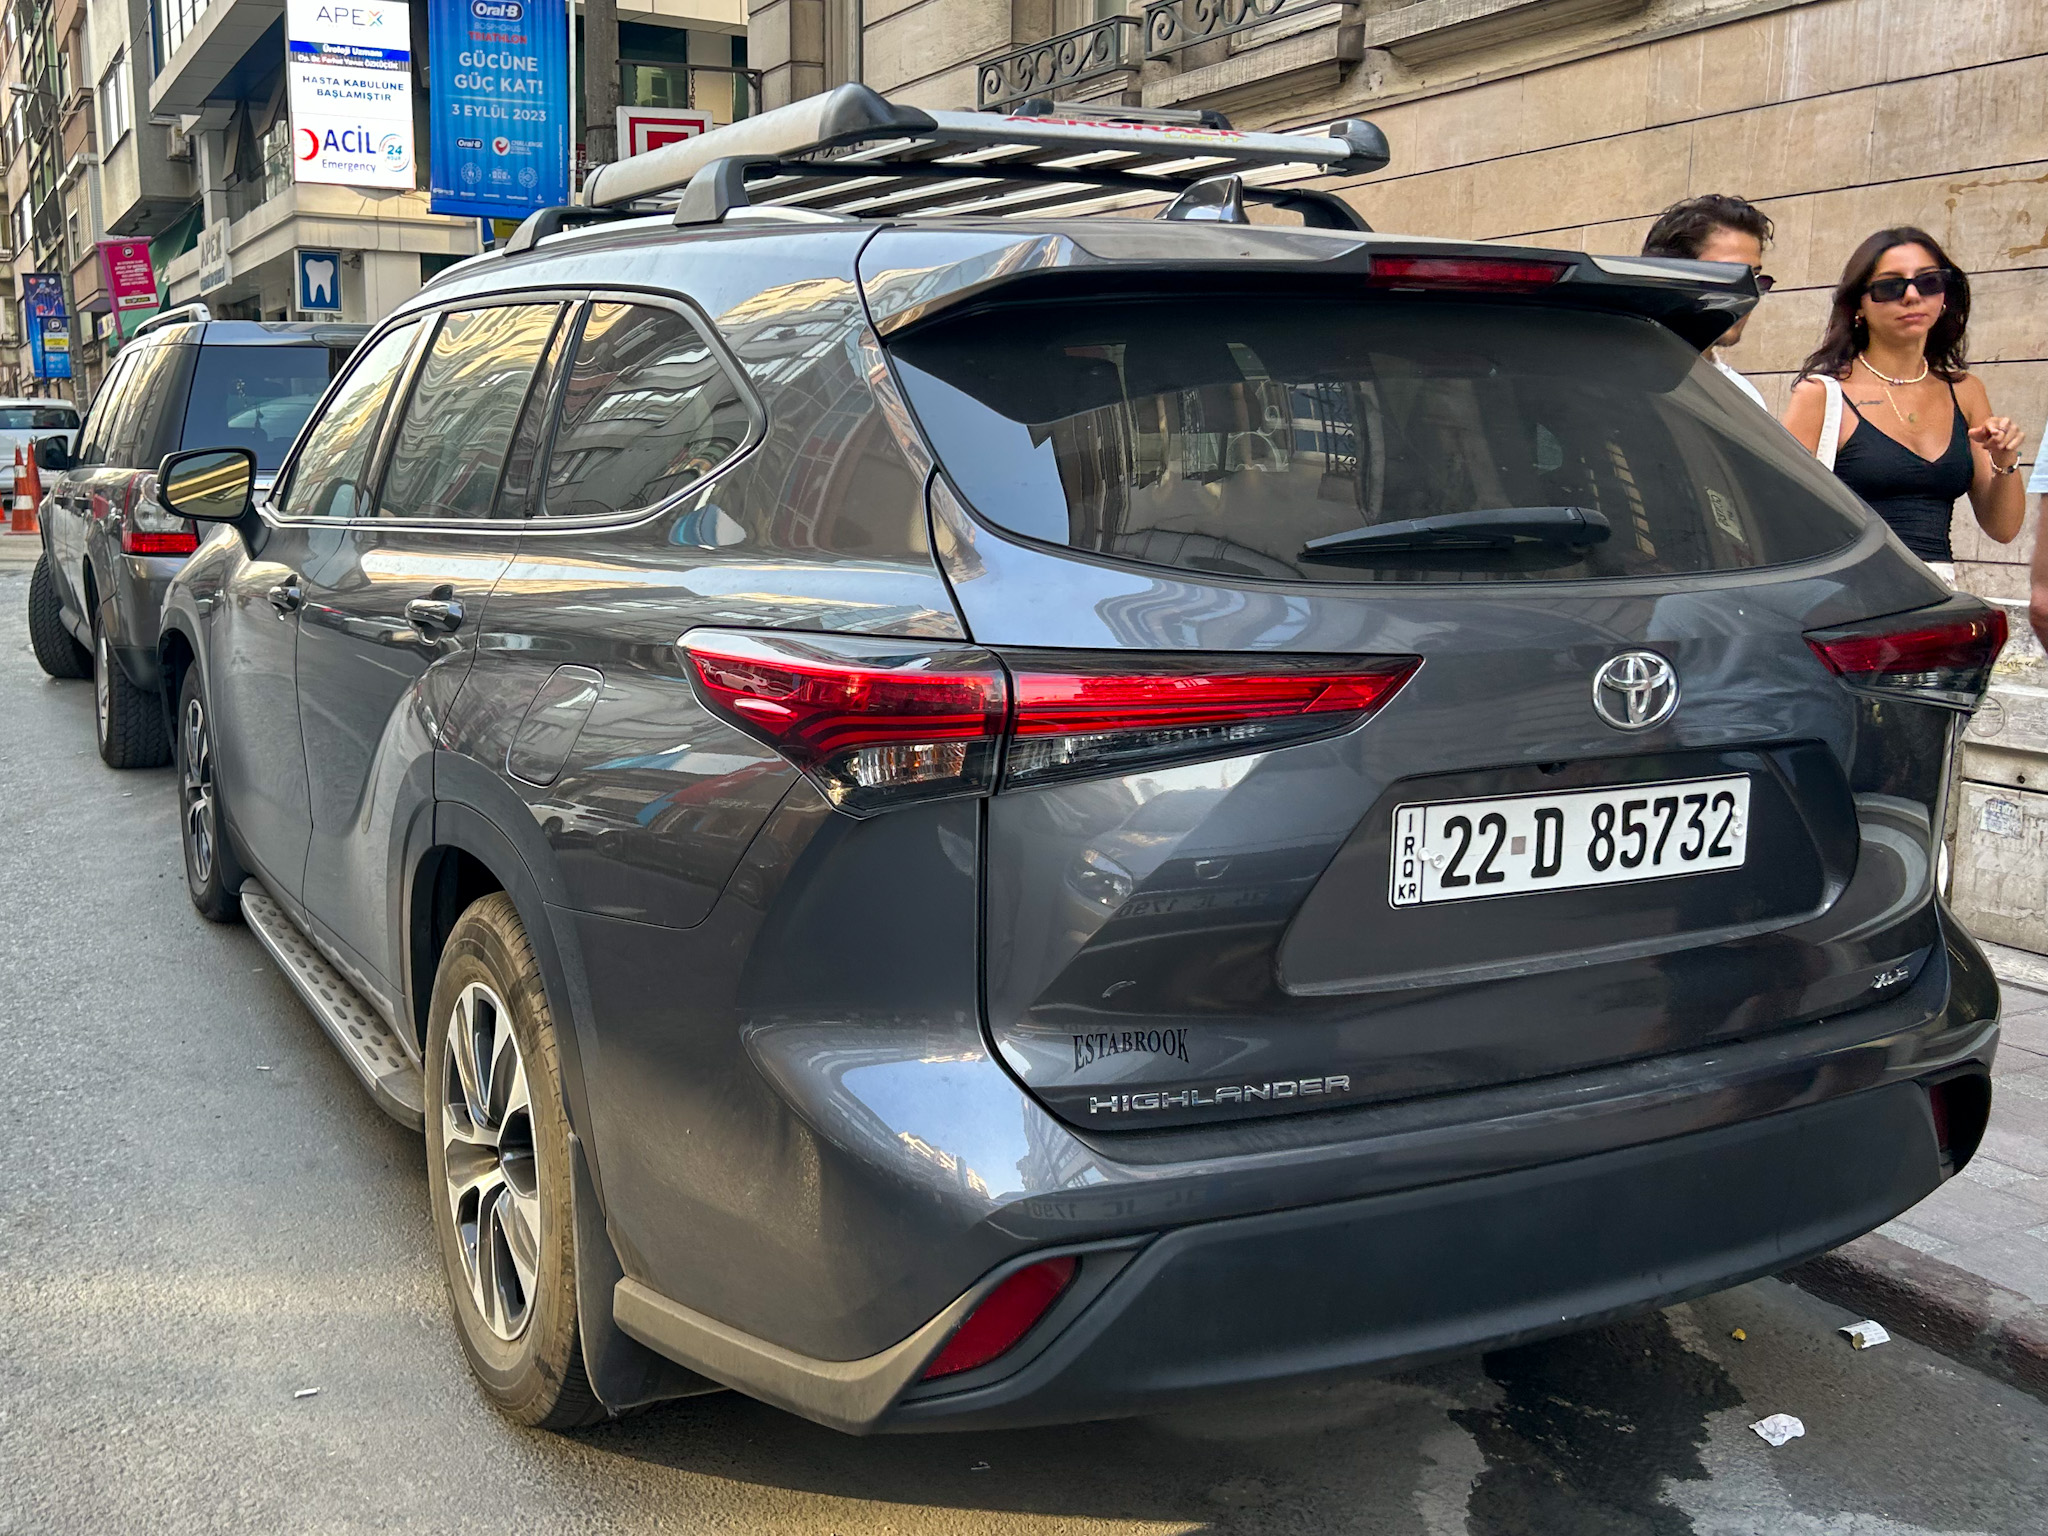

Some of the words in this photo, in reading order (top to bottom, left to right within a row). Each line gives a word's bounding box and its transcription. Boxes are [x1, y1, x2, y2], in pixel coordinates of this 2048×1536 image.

[316, 6, 383, 27] APEX
[475, 2, 519, 17] Oral-B
[468, 31, 527, 44] TRIATHLON
[459, 49, 538, 72] GÜCÜNE
[302, 75, 340, 86] HASTA
[344, 79, 404, 91] KABULÜNE
[454, 71, 494, 93] GÜÇ
[501, 77, 543, 95] KAT!
[317, 88, 392, 101] BAŞLAMIŞTIR
[452, 104, 460, 115] 3
[464, 104, 509, 119] EYLÜL
[513, 108, 547, 121] 2023
[323, 125, 376, 154] ACİL
[387, 144, 402, 156] 24
[322, 159, 376, 173] Emergency
[1440, 811, 1507, 888] 22
[1530, 807, 1564, 879] D
[1587, 791, 1735, 872] 85732
[1397, 882, 1417, 900] KR
[1870, 965, 1909, 989] XLE
[1072, 1028, 1189, 1073] ESTABROOK
[1089, 1074, 1351, 1114] HIGHLANDER
